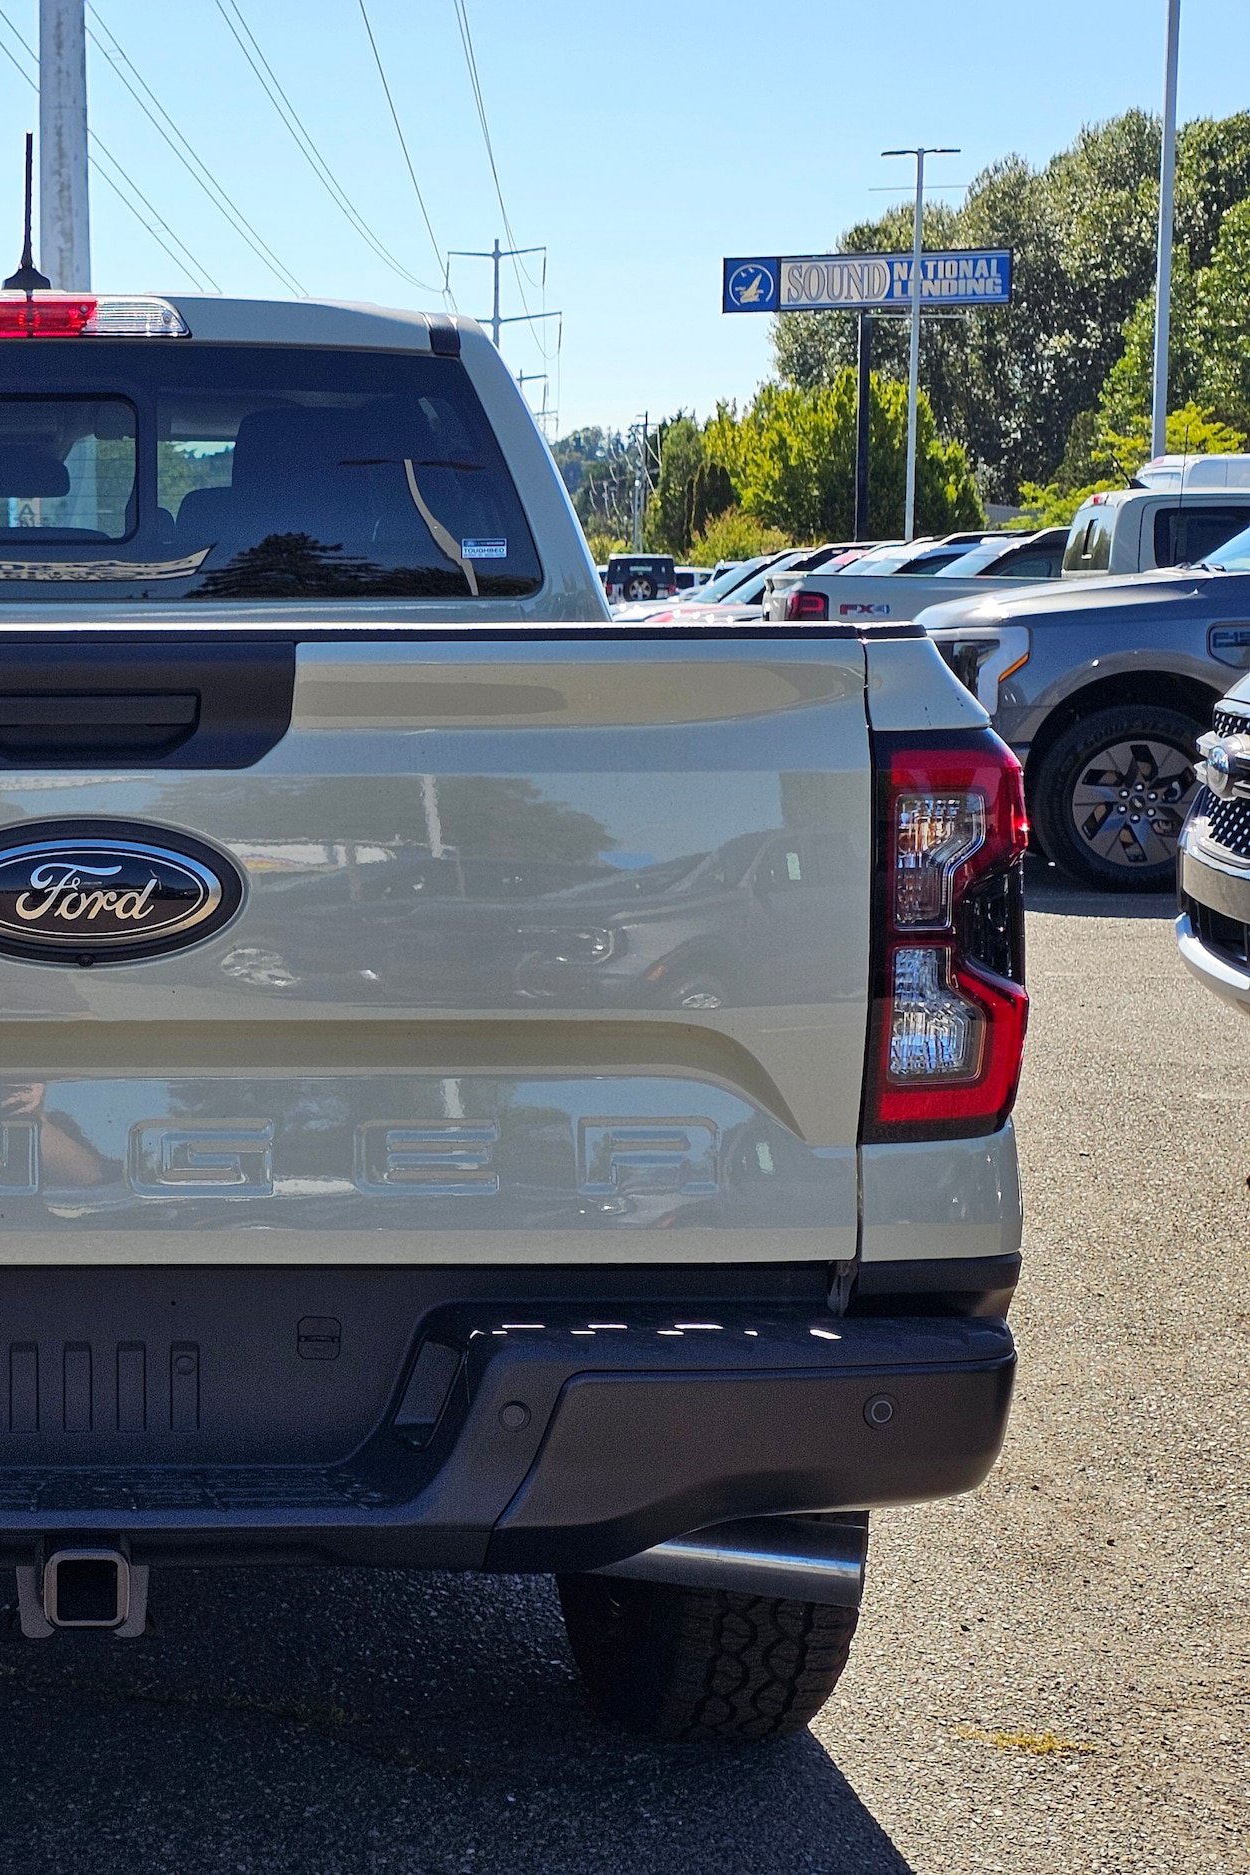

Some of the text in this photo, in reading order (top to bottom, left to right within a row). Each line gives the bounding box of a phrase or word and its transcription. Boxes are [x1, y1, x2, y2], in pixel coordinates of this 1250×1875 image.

[786, 261, 887, 302] SOUND
[894, 258, 1001, 280] NATIONAL
[839, 604, 890, 615] FX4
[15, 862, 155, 921] Ford
